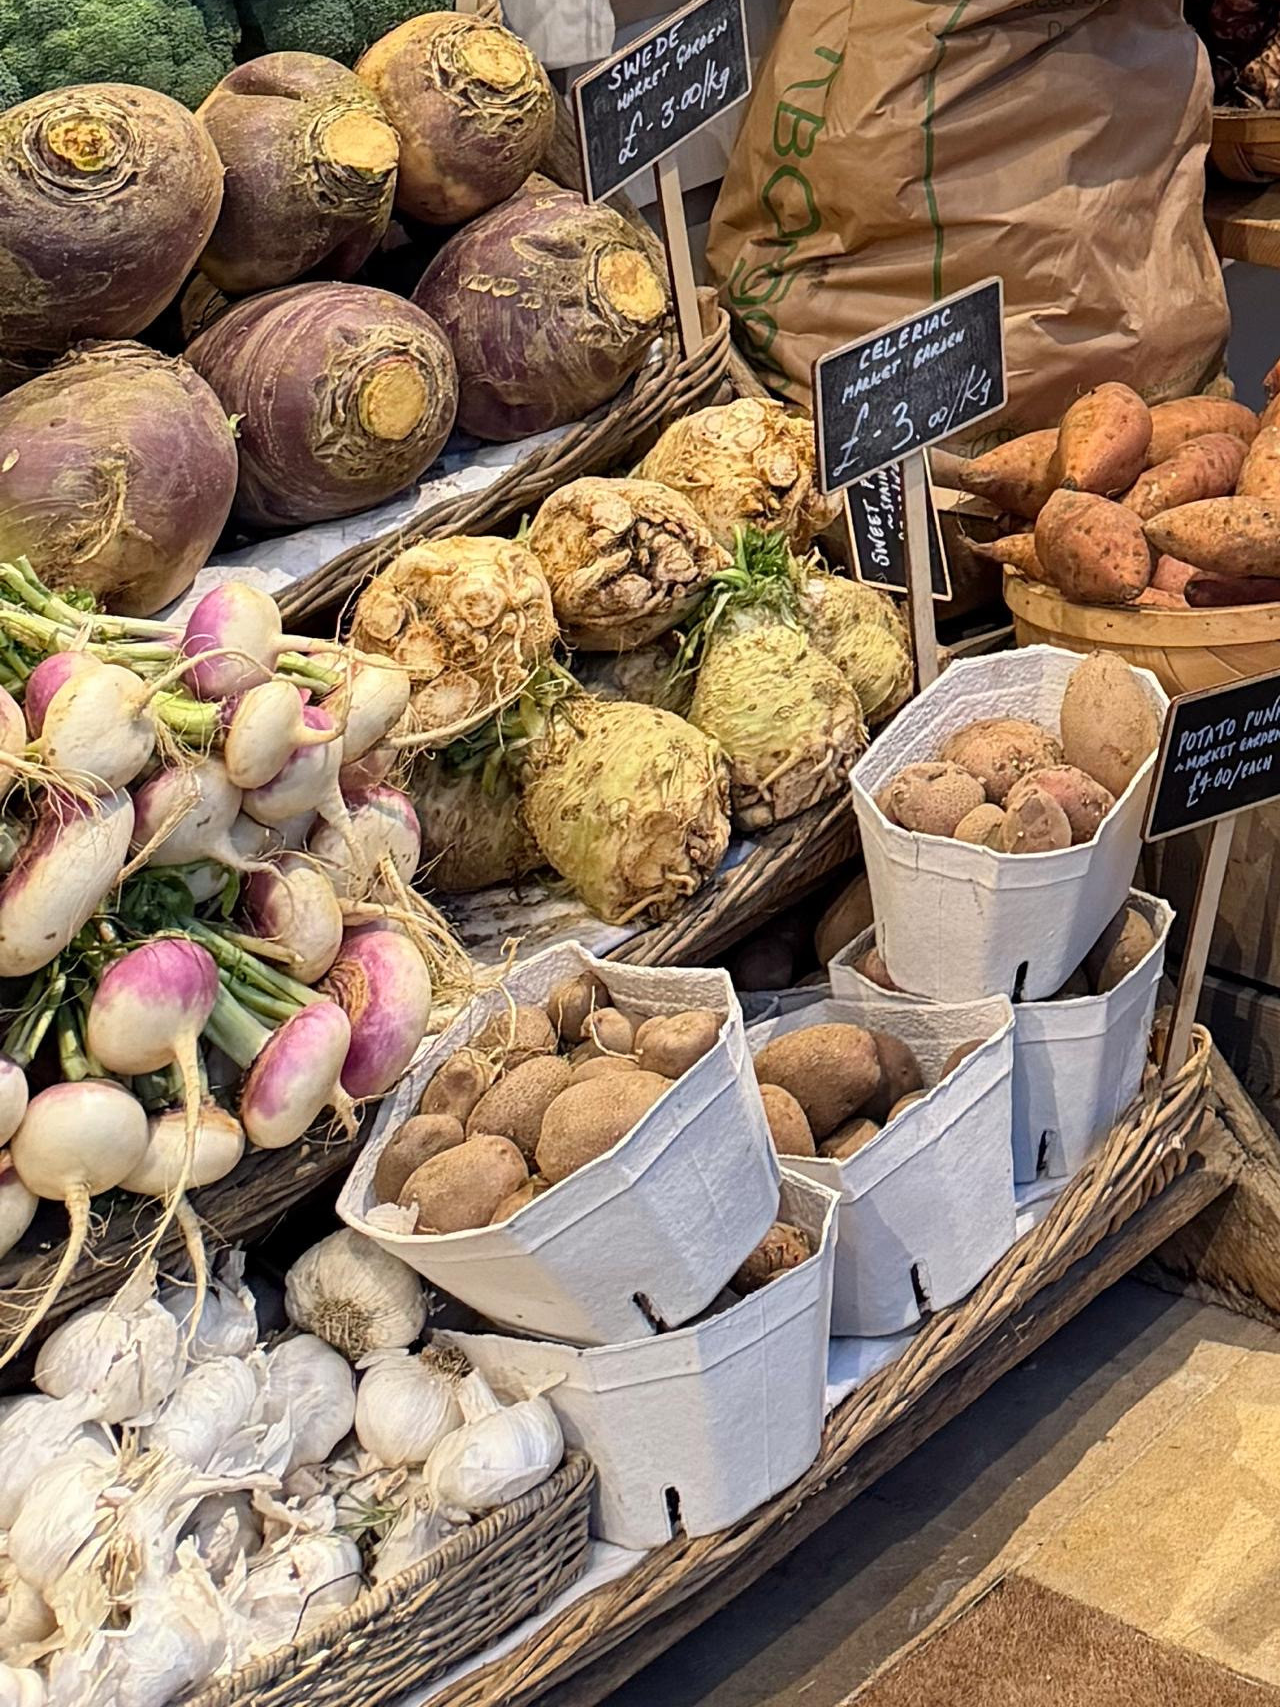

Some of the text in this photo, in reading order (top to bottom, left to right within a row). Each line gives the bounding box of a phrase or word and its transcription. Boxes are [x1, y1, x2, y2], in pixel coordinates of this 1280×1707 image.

[608, 20, 684, 90] SWEDE
[617, 19, 728, 111] MARKET GARDEN
[859, 308, 953, 370] CELERIAC
[842, 360, 902, 404] MARKET
[862, 498, 891, 566] SWEET
[1177, 718, 1236, 757] POTATO
[1185, 741, 1236, 771] MARKET
